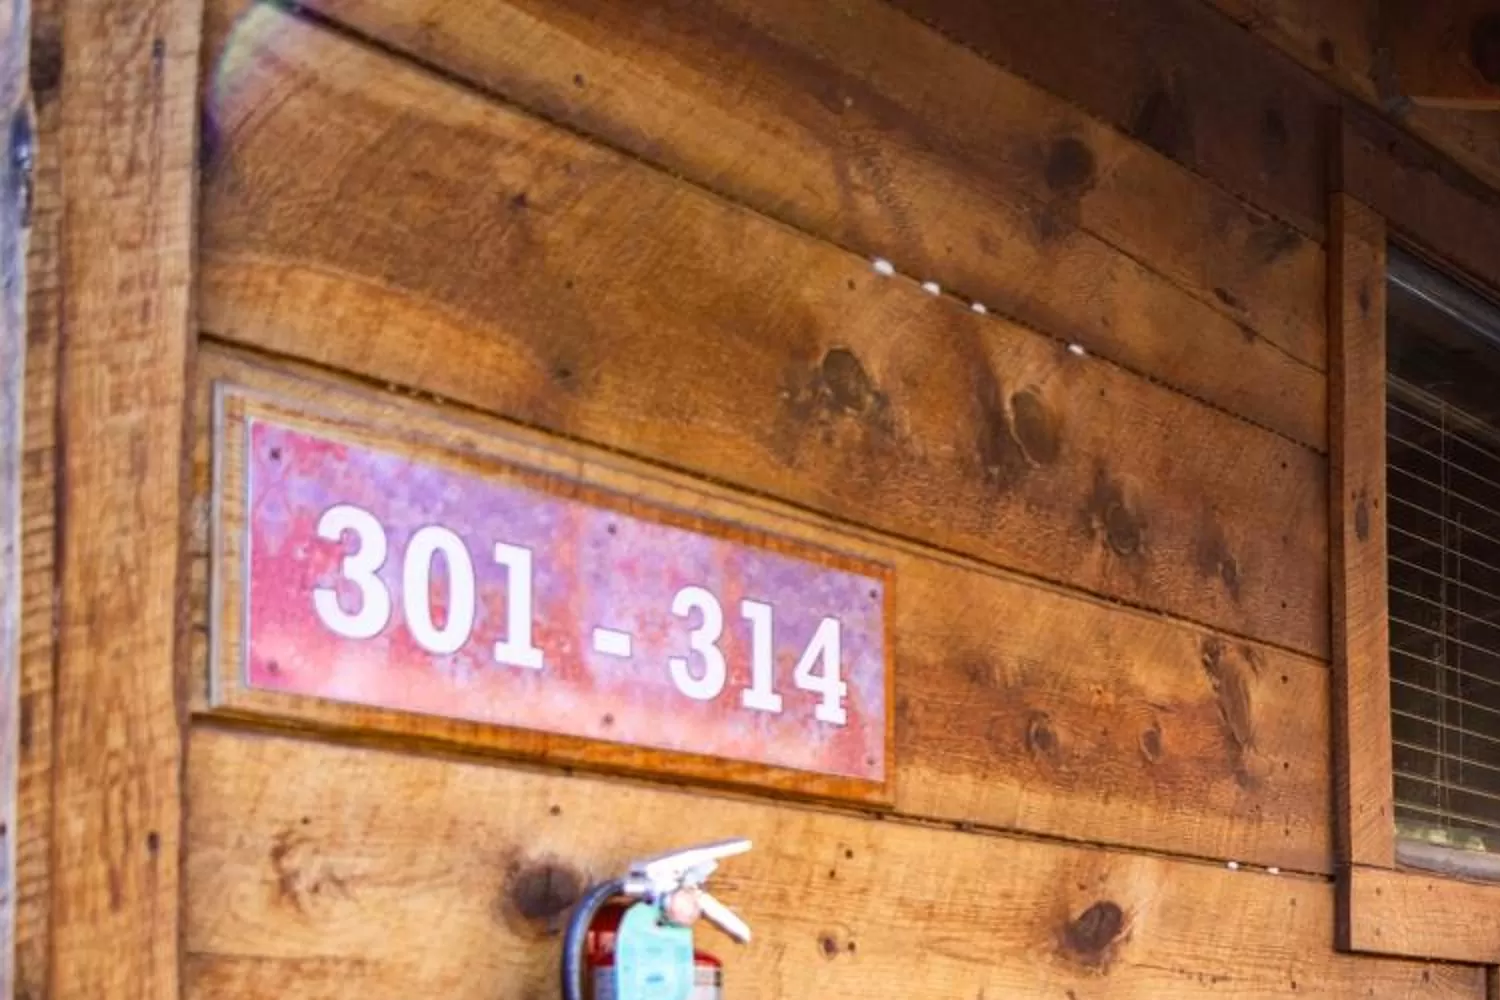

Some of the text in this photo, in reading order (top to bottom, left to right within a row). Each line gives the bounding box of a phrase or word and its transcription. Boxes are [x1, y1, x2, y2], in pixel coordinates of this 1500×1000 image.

[313, 503, 849, 726] 301 - 314
